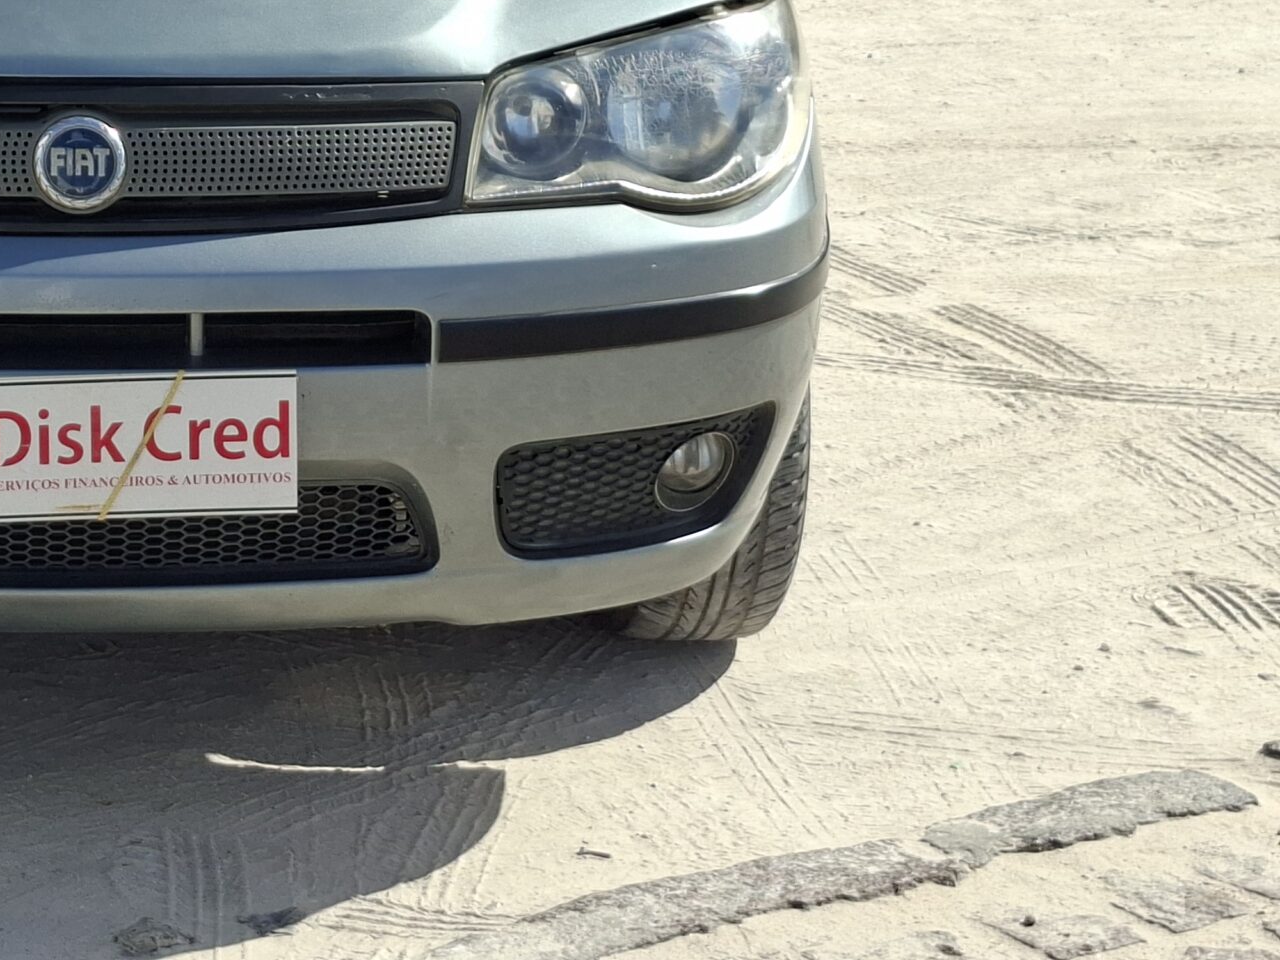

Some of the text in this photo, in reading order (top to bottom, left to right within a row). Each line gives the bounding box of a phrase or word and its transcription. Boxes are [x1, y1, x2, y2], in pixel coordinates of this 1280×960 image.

[50, 147, 110, 177] FIAT
[143, 400, 290, 462] Cred
[167, 474, 178, 486] &
[182, 471, 291, 486] AUTOMOTIVOS
